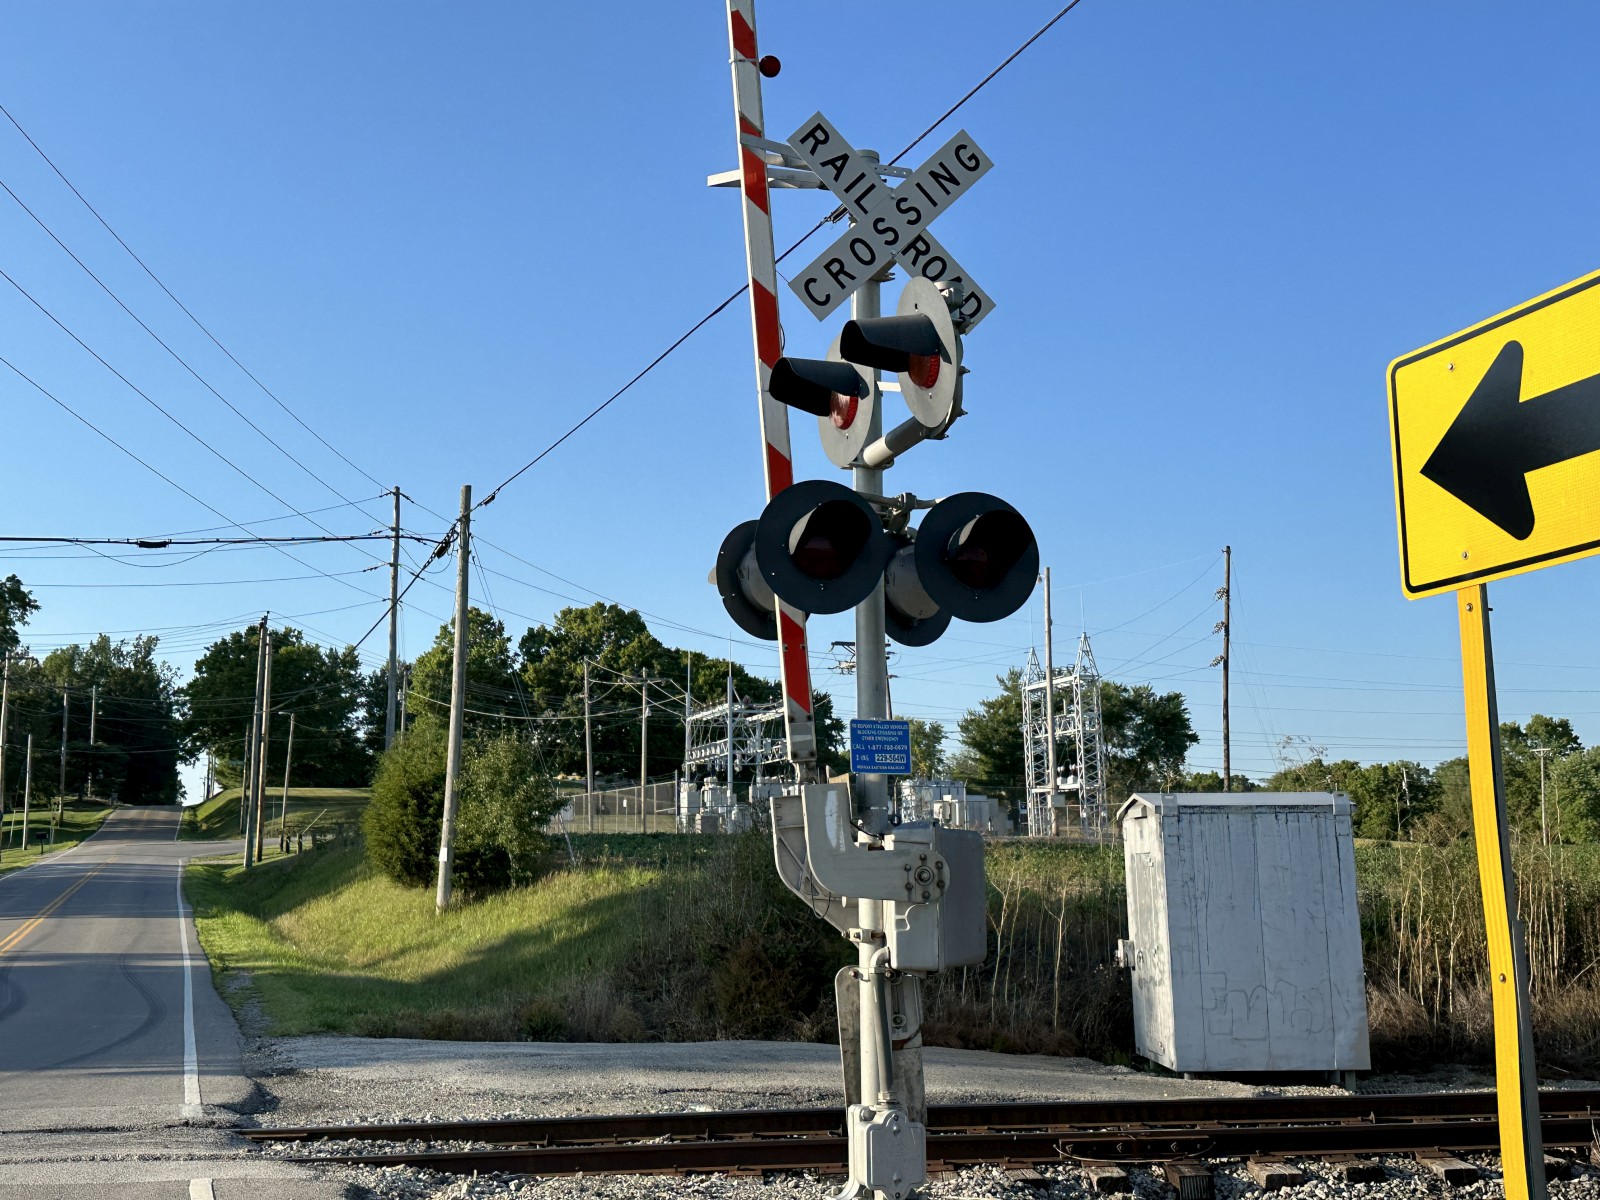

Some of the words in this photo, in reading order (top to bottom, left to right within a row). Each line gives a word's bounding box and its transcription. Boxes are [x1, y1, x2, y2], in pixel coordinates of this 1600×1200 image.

[799, 123, 876, 214] RAIL
[901, 233, 982, 319] ROD
[803, 143, 981, 306] CROSSING
